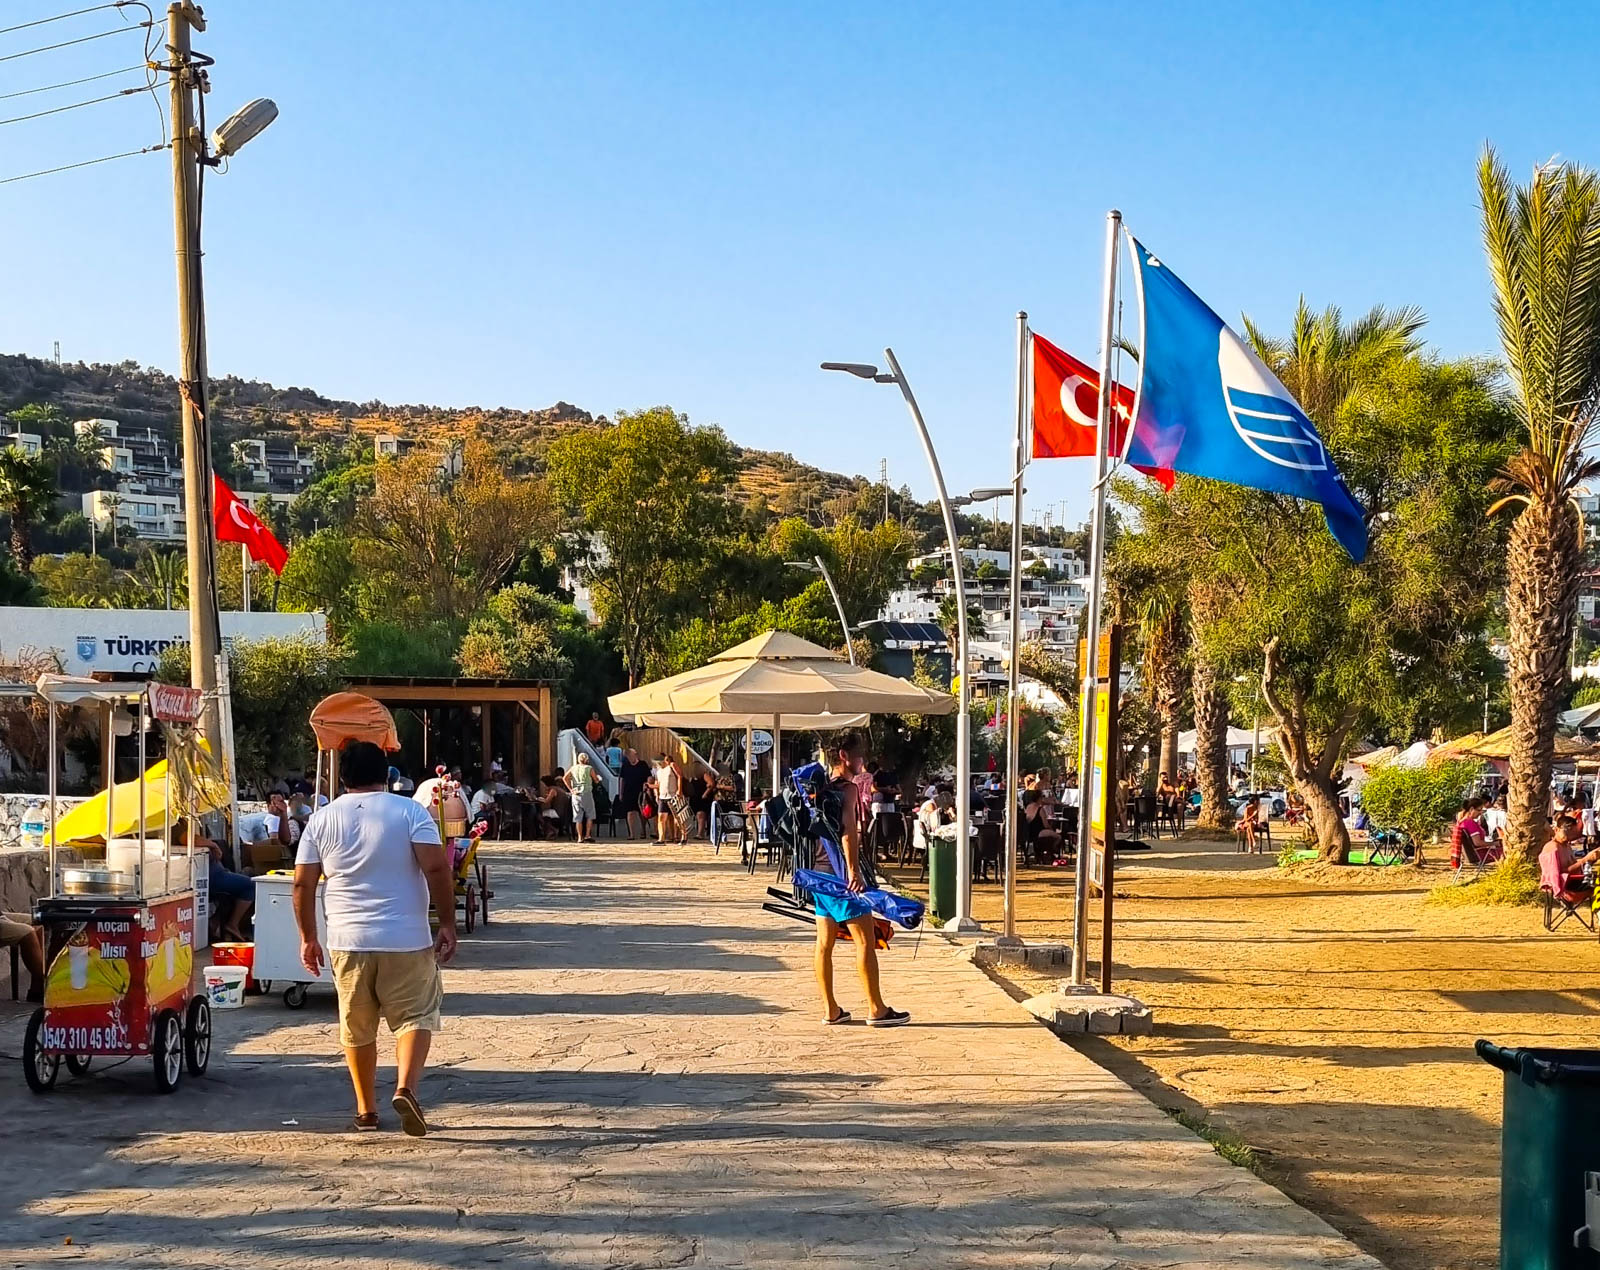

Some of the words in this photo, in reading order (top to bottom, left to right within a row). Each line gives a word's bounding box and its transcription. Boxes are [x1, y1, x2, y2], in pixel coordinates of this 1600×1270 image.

[97, 921, 130, 937] Koçan
[69, 1027, 87, 1049] 310
[90, 1027, 102, 1049] 45
[104, 1026, 117, 1049] 98
